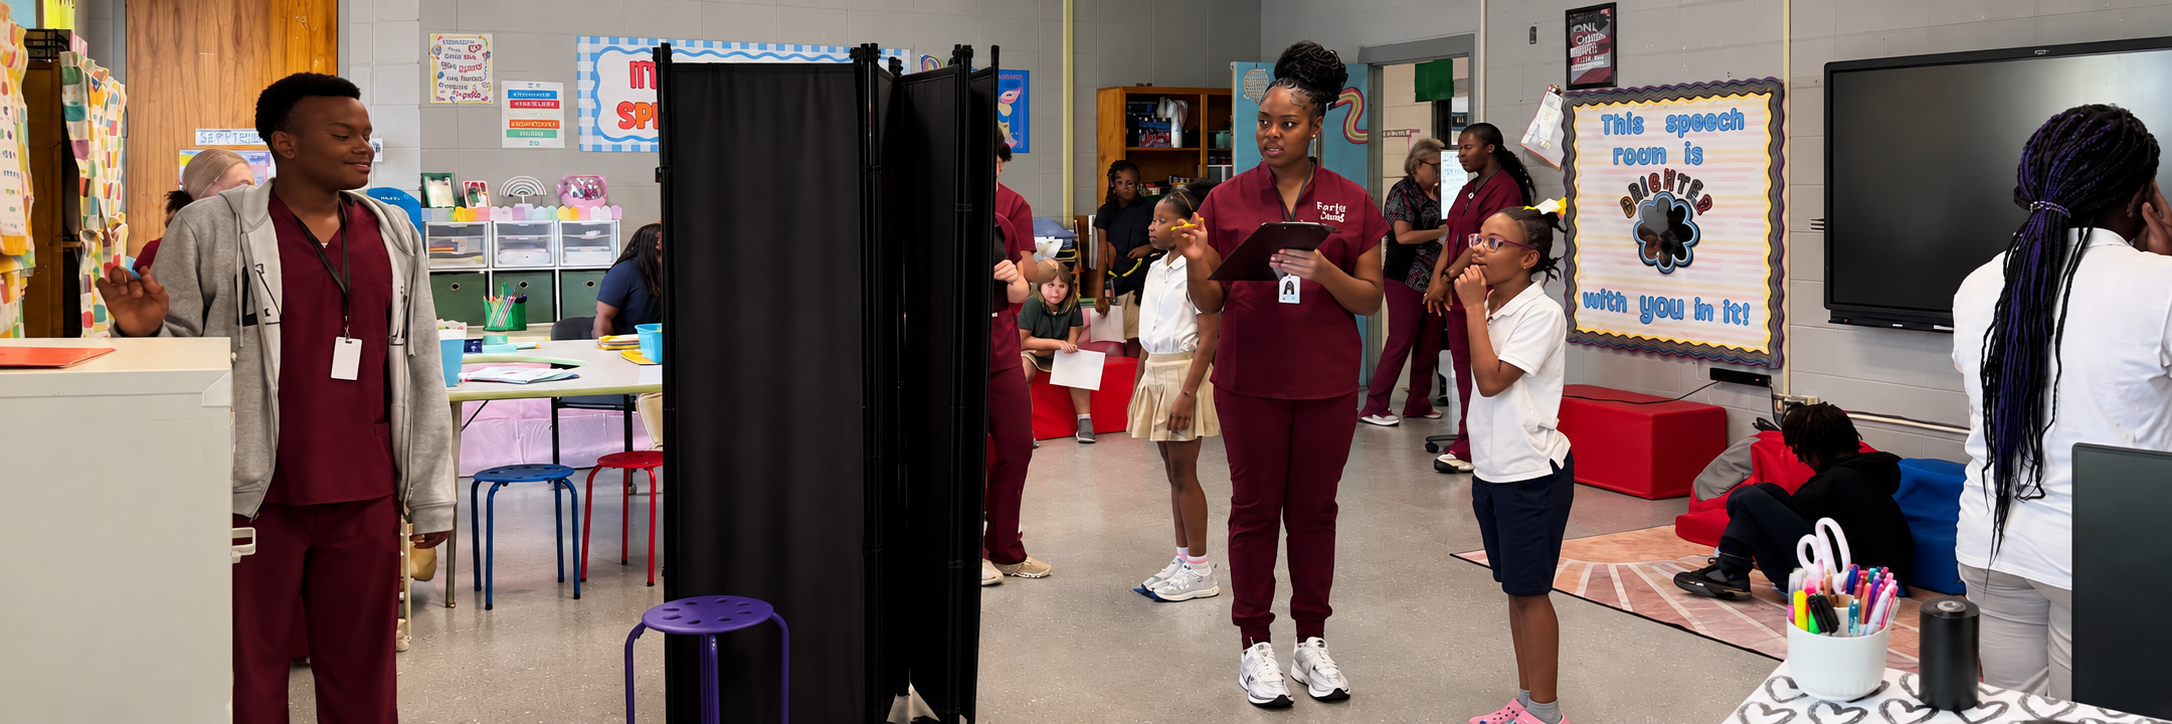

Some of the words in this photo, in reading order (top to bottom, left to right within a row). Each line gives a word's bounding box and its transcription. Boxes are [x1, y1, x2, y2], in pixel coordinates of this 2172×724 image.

[1601, 111, 1645, 135] This
[1665, 107, 1745, 139] speech
[1684, 141, 1703, 166] is
[1582, 288, 1628, 313] with
[1639, 294, 1685, 325] you
[1694, 296, 1714, 322] in
[1722, 298, 1750, 327] it!
